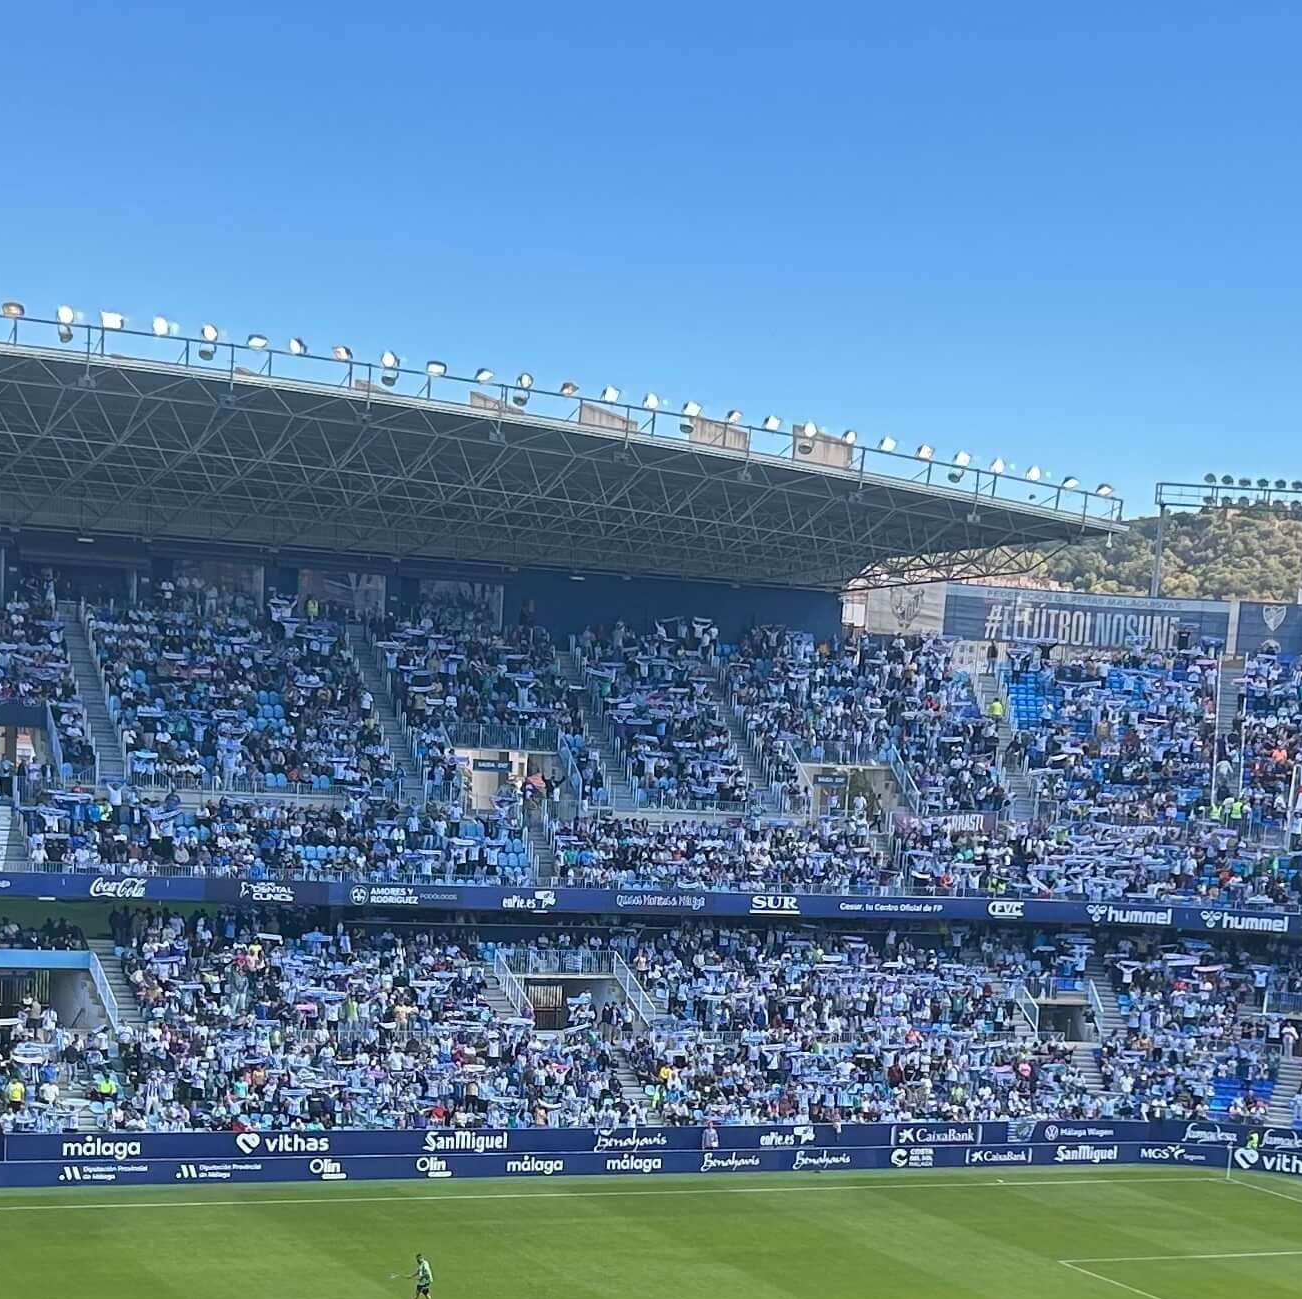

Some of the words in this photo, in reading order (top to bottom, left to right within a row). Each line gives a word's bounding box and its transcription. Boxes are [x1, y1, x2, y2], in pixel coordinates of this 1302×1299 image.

[370, 887, 405, 896] AMORES
[751, 895, 799, 910] SUR
[1107, 906, 1172, 925] hummel
[1222, 913, 1289, 932] hummel
[916, 1128, 974, 1142] CaixaBank
[265, 1134, 329, 1152] vithas
[983, 1150, 1027, 1162] CaixaBank
[1140, 1148, 1169, 1159] MGS
[309, 1158, 341, 1174] Olin
[416, 1156, 447, 1172] Olin
